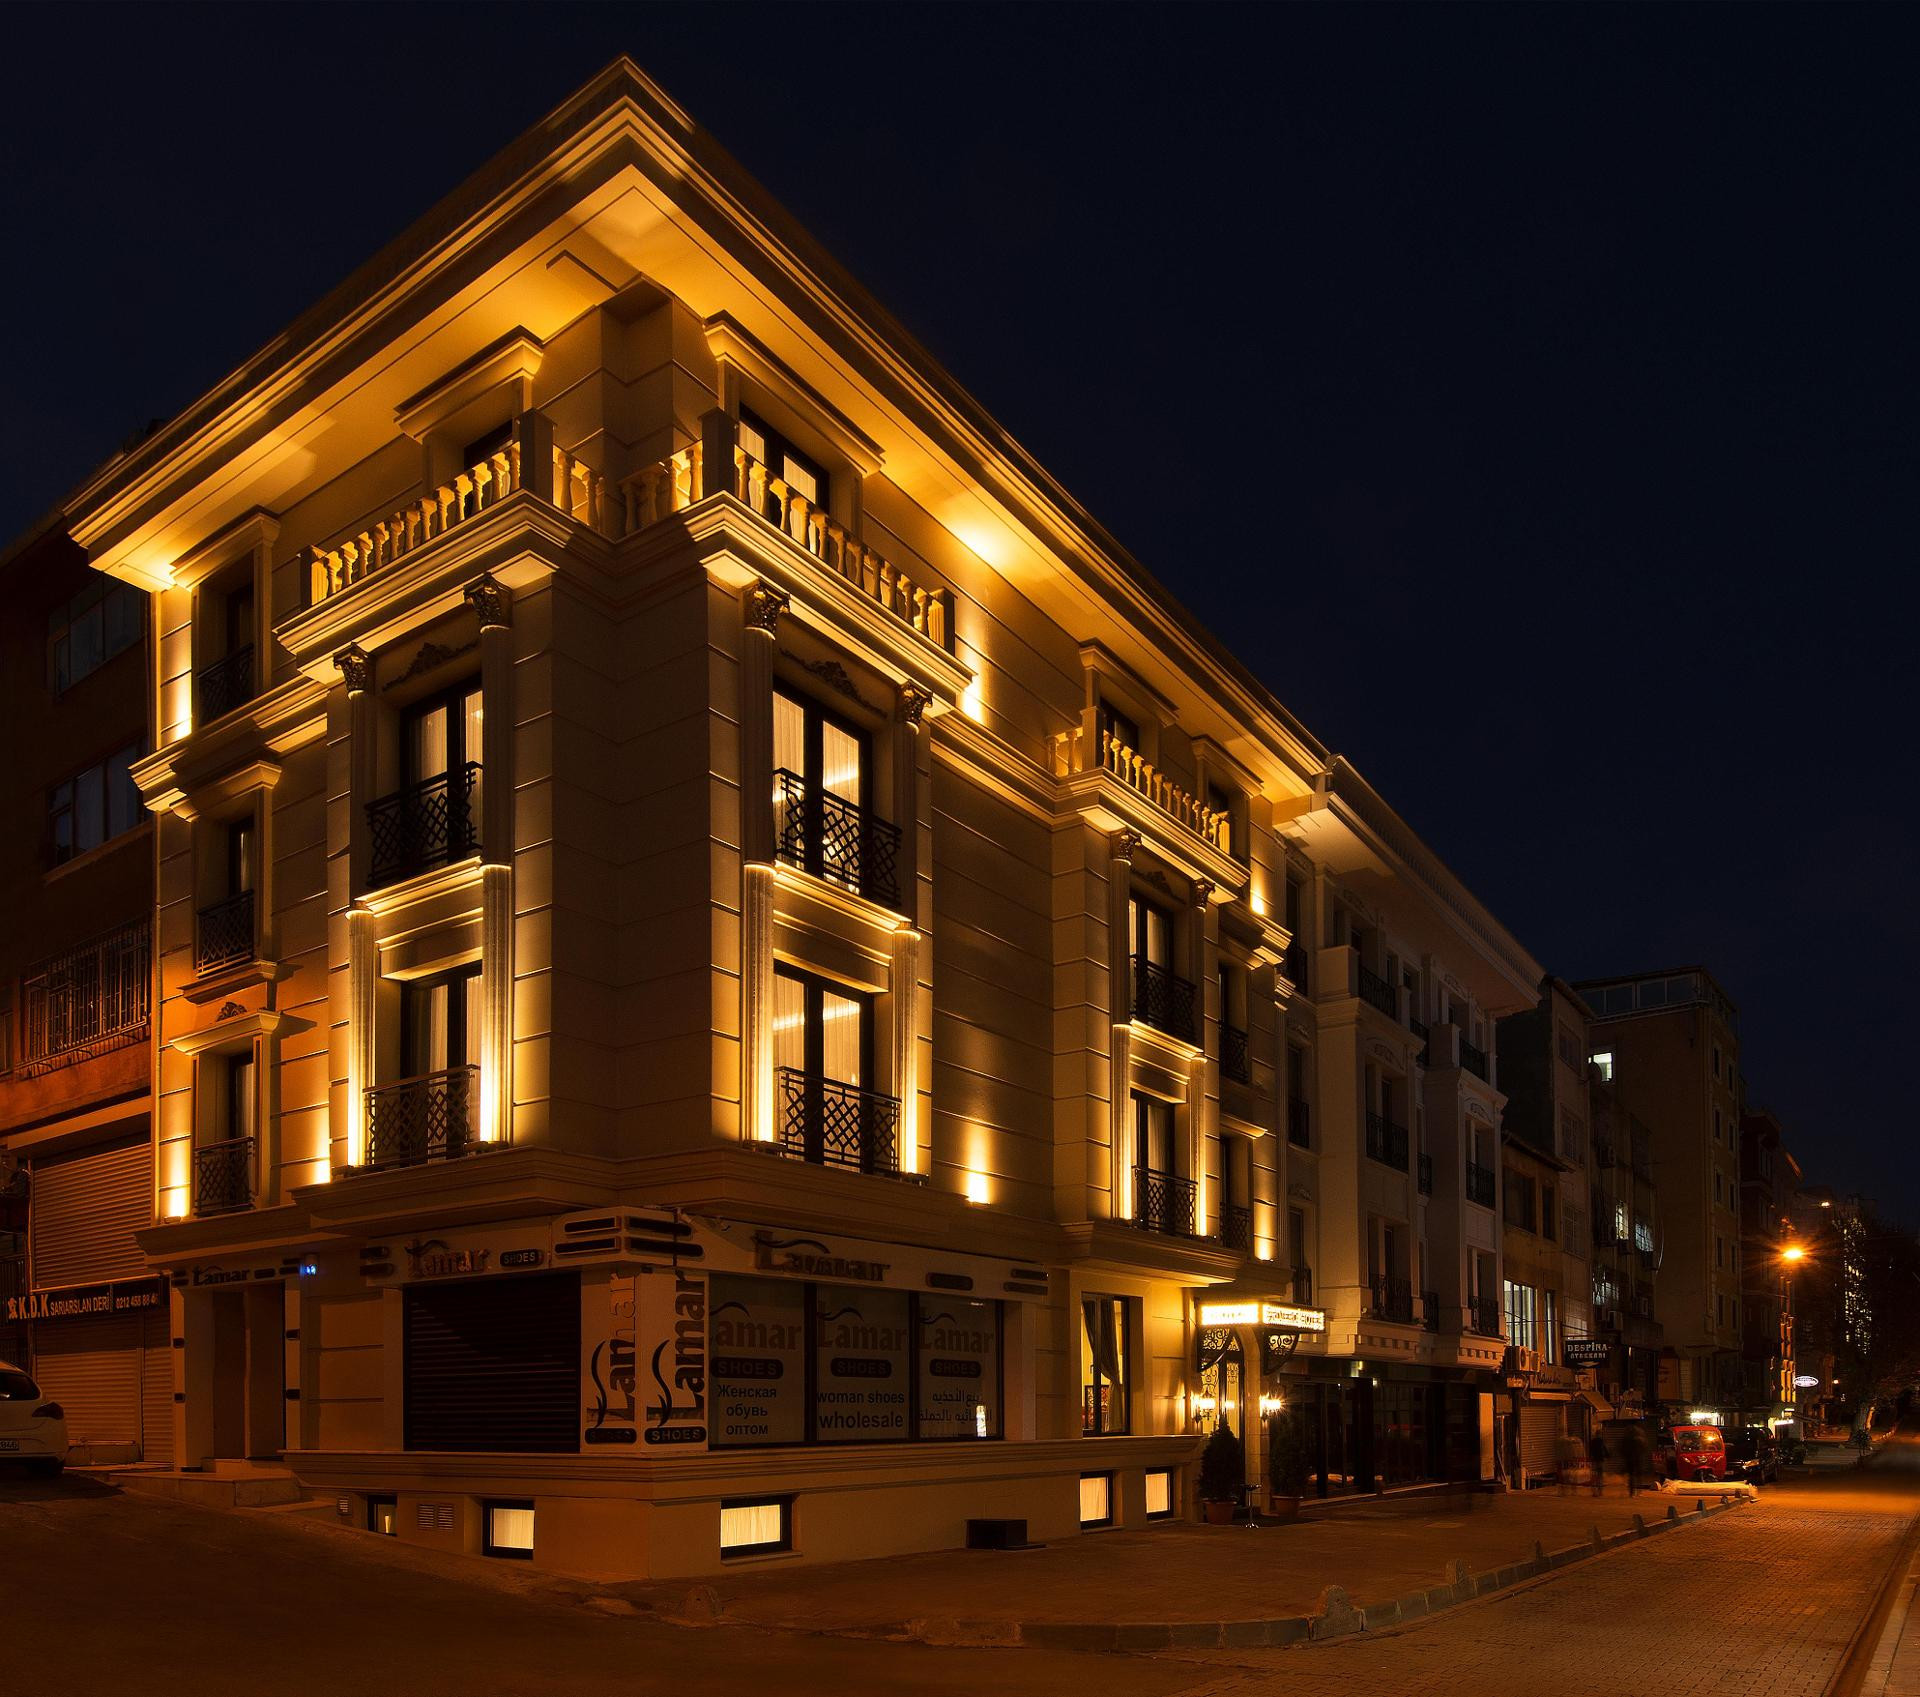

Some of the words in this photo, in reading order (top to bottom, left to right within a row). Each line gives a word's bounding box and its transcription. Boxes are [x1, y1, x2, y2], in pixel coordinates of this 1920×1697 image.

[503, 1250, 536, 1265] SHOES
[713, 1320, 802, 1350] amar
[919, 1307, 994, 1354] Lamar
[647, 1268, 705, 1421] Lamar
[719, 1360, 777, 1376] SHOES
[837, 1360, 887, 1375] SHOES
[935, 1361, 977, 1375] SHOES
[718, 1384, 777, 1398] Женская
[816, 1391, 864, 1404] woman
[868, 1388, 905, 1404] shoes
[726, 1403, 769, 1419] обувь
[819, 1410, 904, 1429] wholesale
[652, 1429, 700, 1441] SHOES
[726, 1424, 769, 1436] оптом
